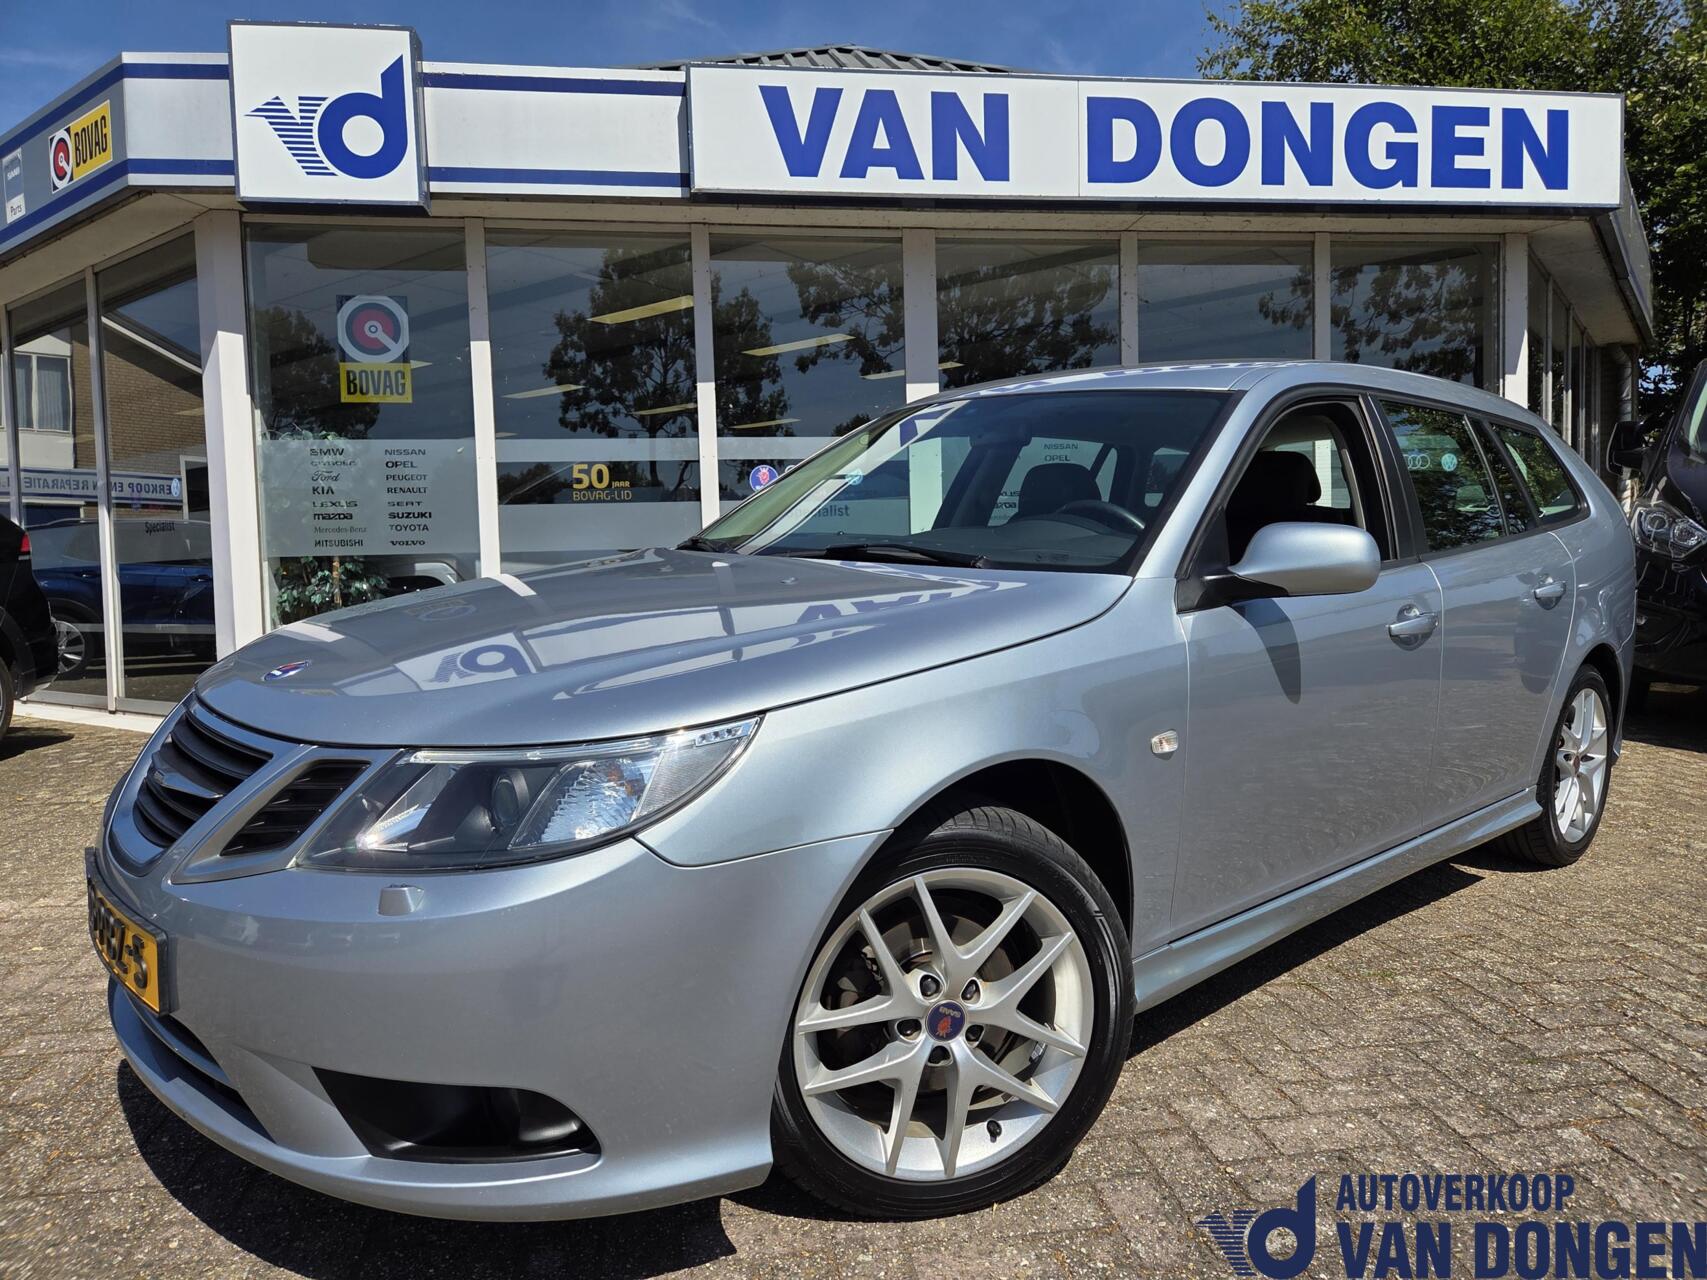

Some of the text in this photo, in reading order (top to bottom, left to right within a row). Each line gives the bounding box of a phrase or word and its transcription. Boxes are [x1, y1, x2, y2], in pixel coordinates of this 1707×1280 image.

[74, 115, 108, 168] BOVAG
[759, 85, 1569, 191] VAN DONGEN
[346, 369, 407, 396] BOVAG
[384, 448, 426, 456] NISSAN
[1044, 454, 1071, 462] OPEL
[385, 460, 418, 469] OPEL
[311, 470, 341, 482] Ford
[386, 473, 428, 481] PEUGEOT
[572, 463, 631, 490] 50 JAAR
[312, 486, 335, 495] KIA
[386, 486, 428, 494] RENAULT
[572, 490, 633, 502] BOVAG-LID
[312, 500, 358, 508] LEXUS
[388, 511, 432, 519] SUZUKI
[389, 523, 429, 532] TOYOTA
[314, 538, 363, 548] MITSUBISHI
